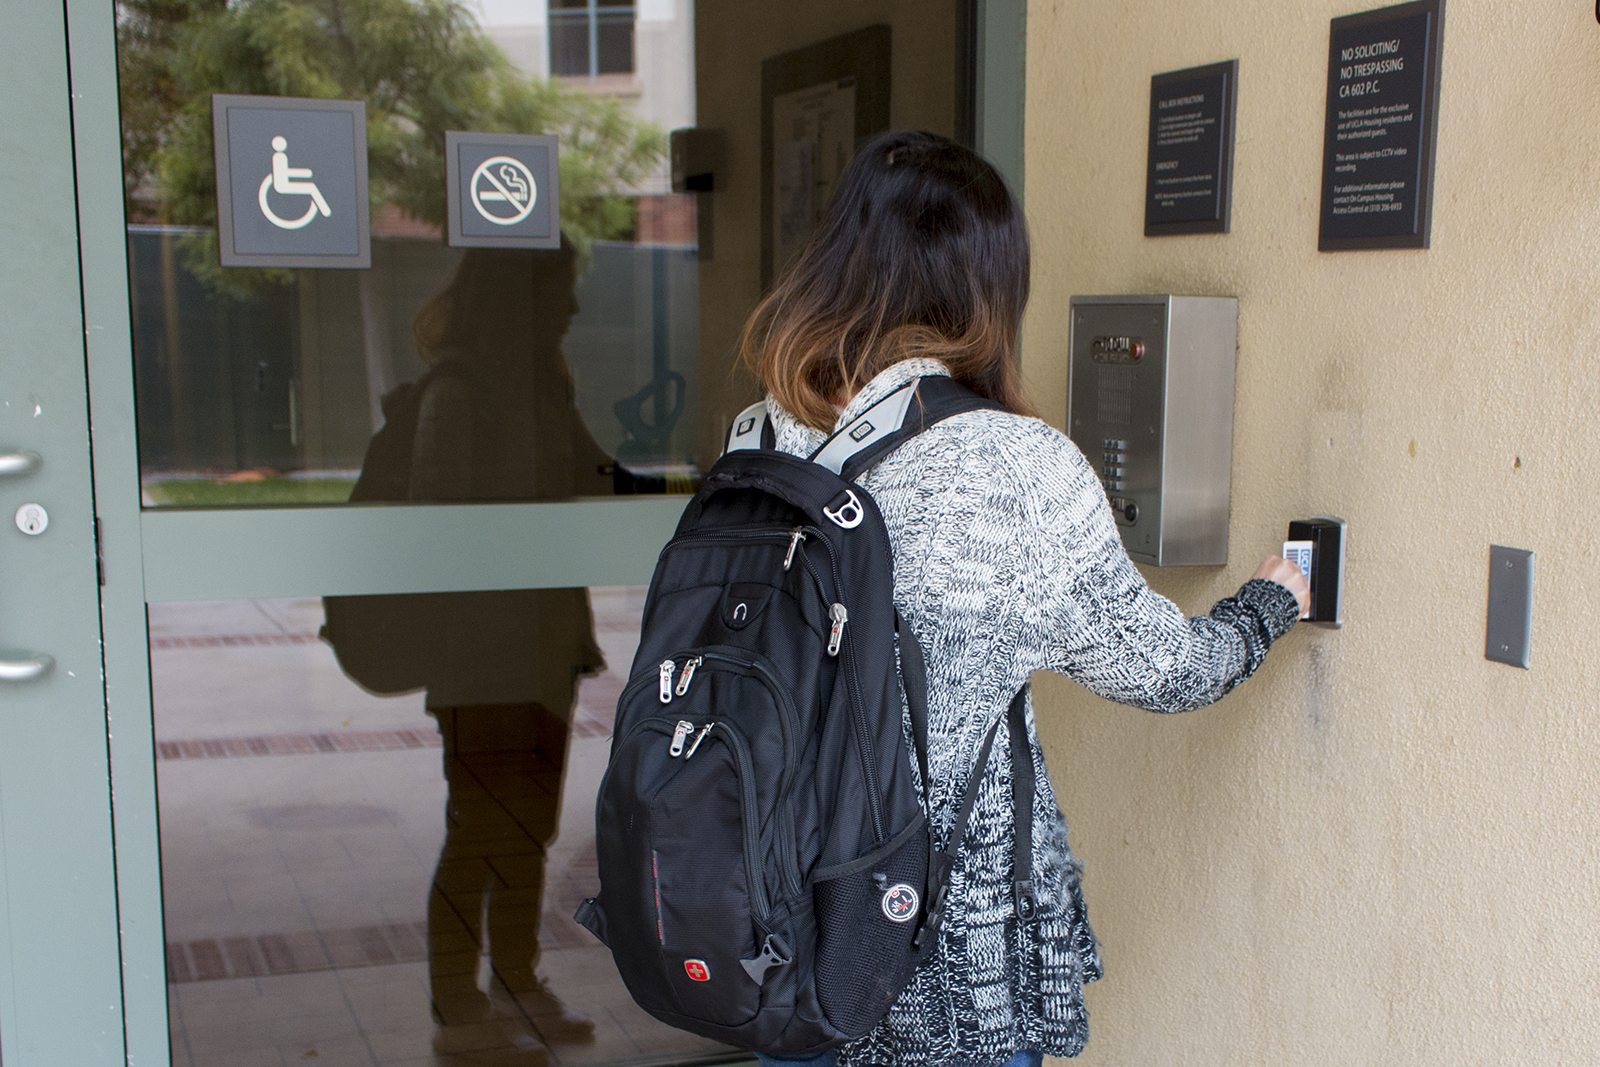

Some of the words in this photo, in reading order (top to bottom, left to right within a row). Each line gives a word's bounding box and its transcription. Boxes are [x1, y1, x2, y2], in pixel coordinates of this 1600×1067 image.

[1341, 47, 1354, 61] NO
[1354, 39, 1401, 60] SOLICITING/
[1340, 65, 1353, 80] NO
[1353, 57, 1404, 78] TRESPASSING
[1339, 85, 1350, 98] CA
[1350, 82, 1365, 96] 602
[1366, 80, 1380, 94] P.C.
[1380, 105, 1388, 114] the
[1388, 103, 1409, 112] exclusive
[1337, 122, 1345, 130] use
[1345, 121, 1351, 129] of
[1350, 119, 1363, 128] UCLA
[1382, 115, 1403, 124] residents
[1403, 112, 1413, 122] and
[1337, 132, 1348, 141] their
[1347, 129, 1372, 140] authorized
[1345, 153, 1355, 161] area
[1355, 152, 1359, 160] is
[1359, 151, 1375, 160] subject
[1375, 150, 1381, 158] to
[1381, 148, 1394, 157] CCTV
[1393, 147, 1407, 156] video
[1333, 185, 1341, 193] For
[1341, 183, 1364, 193] additional
[1363, 182, 1390, 191] information
[1389, 181, 1405, 190] please
[1333, 195, 1350, 204] contact
[1349, 194, 1357, 203] On
[1356, 194, 1375, 203] Campus
[1374, 193, 1394, 202] Housing
[1332, 206, 1347, 214] Access
[1347, 204, 1364, 214] Control
[1364, 205, 1369, 213] at
[1301, 551, 1309, 576] UCLA
